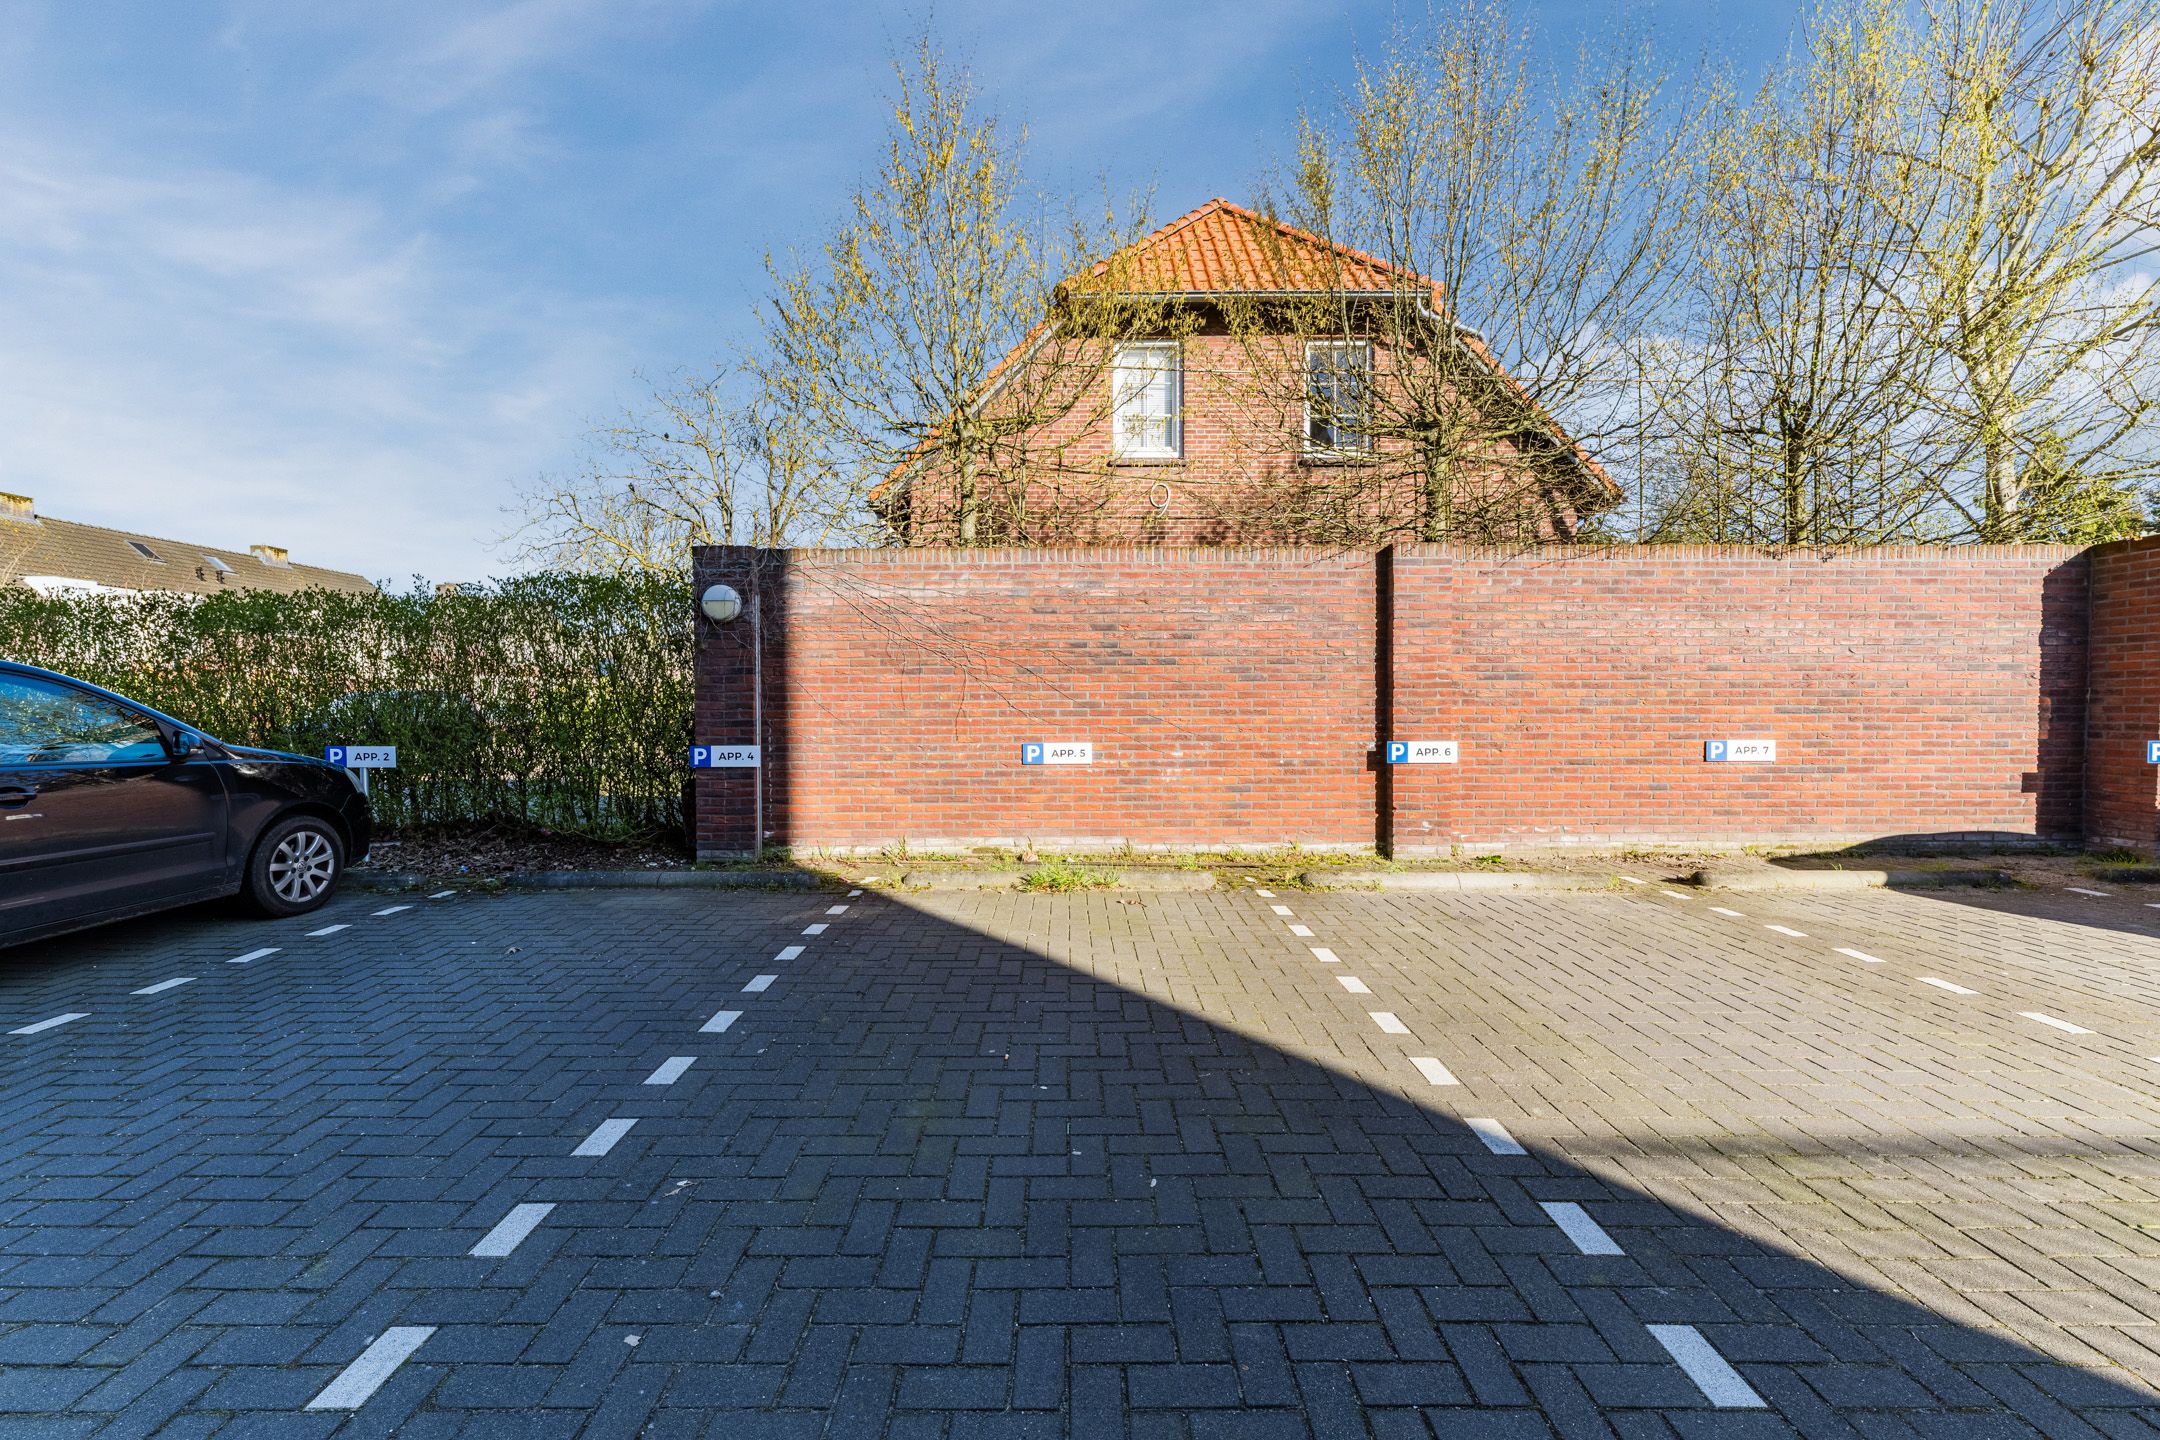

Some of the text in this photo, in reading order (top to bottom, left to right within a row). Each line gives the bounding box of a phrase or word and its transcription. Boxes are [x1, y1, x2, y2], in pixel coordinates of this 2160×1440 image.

[1150, 483, 1171, 518] 9
[329, 748, 390, 763] P APP. 2
[694, 748, 755, 766] P APP. 4
[1027, 745, 1086, 763] P APP. 5
[1391, 743, 1451, 762] P APP. 6
[1710, 741, 1769, 759] P APP. 7
